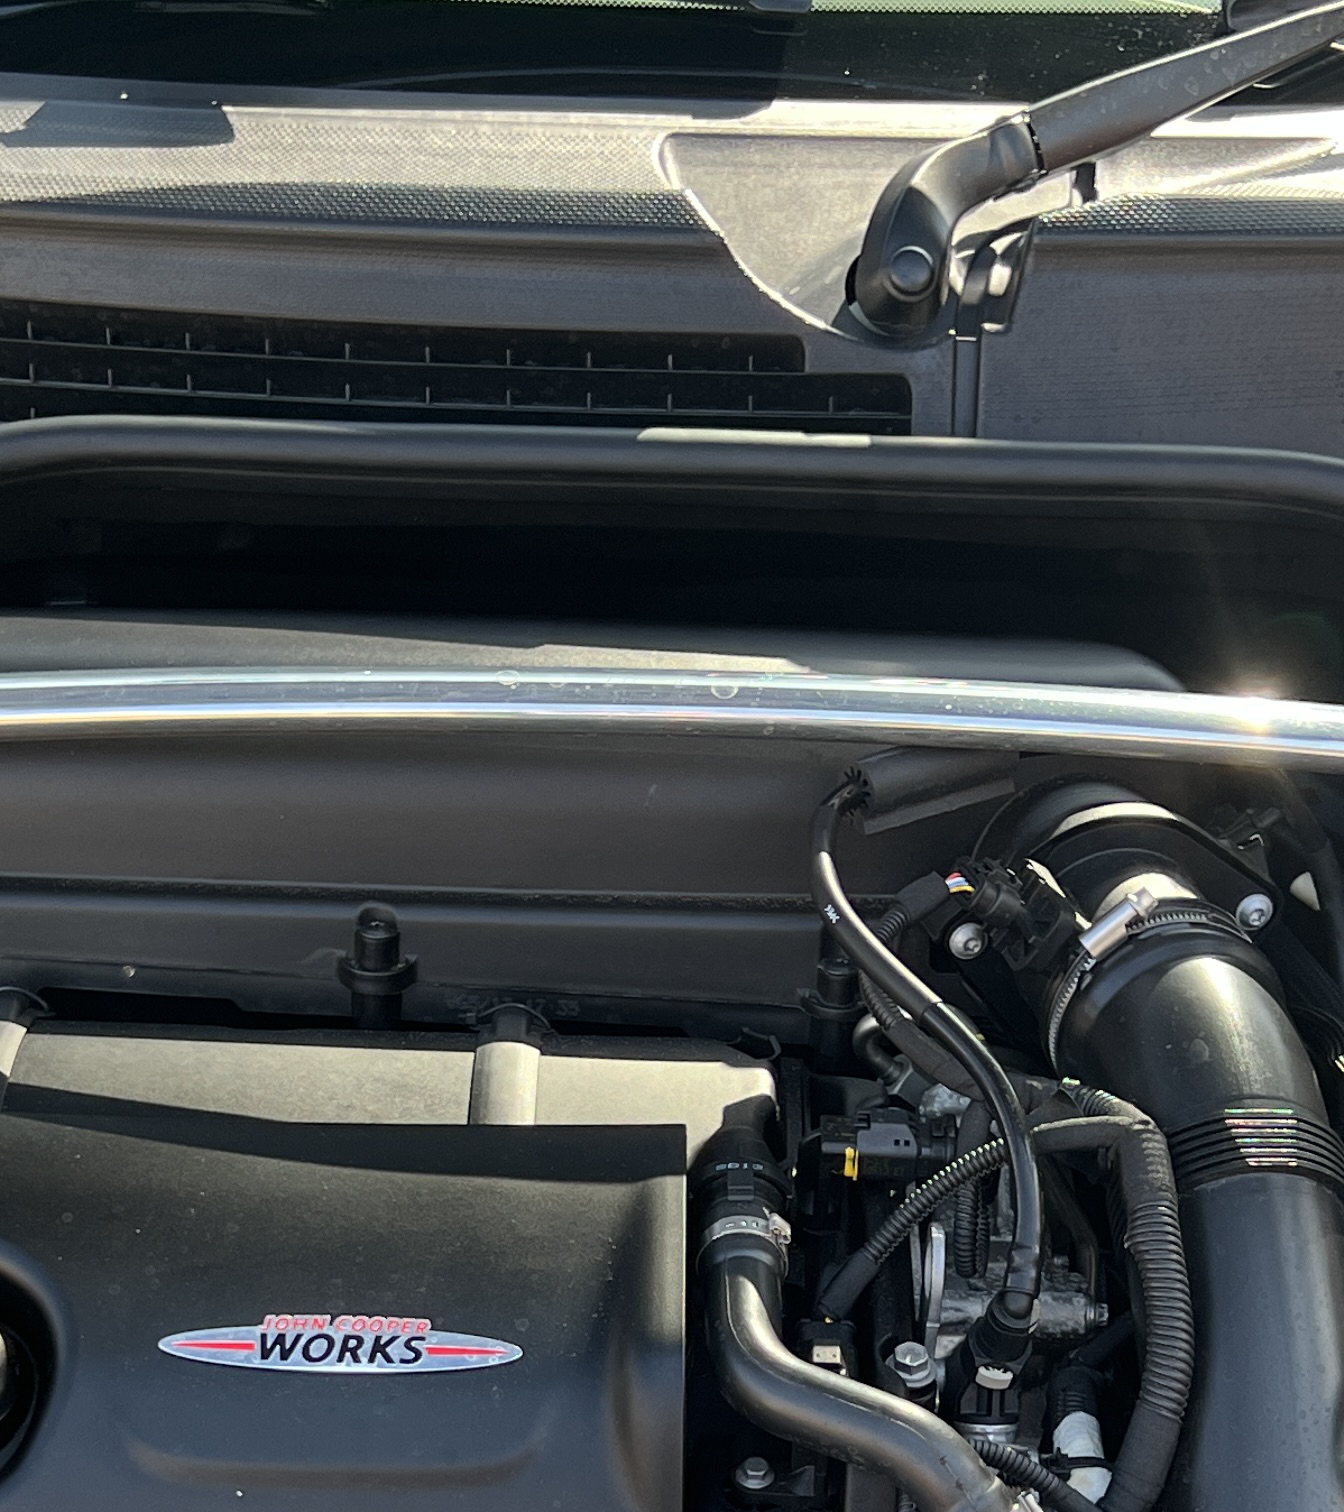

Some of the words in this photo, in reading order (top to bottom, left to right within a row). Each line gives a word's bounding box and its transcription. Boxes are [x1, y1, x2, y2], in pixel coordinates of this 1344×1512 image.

[261, 1316, 329, 1332] JOHN
[335, 1317, 431, 1335] COOPER
[258, 1333, 428, 1366] WORKS
